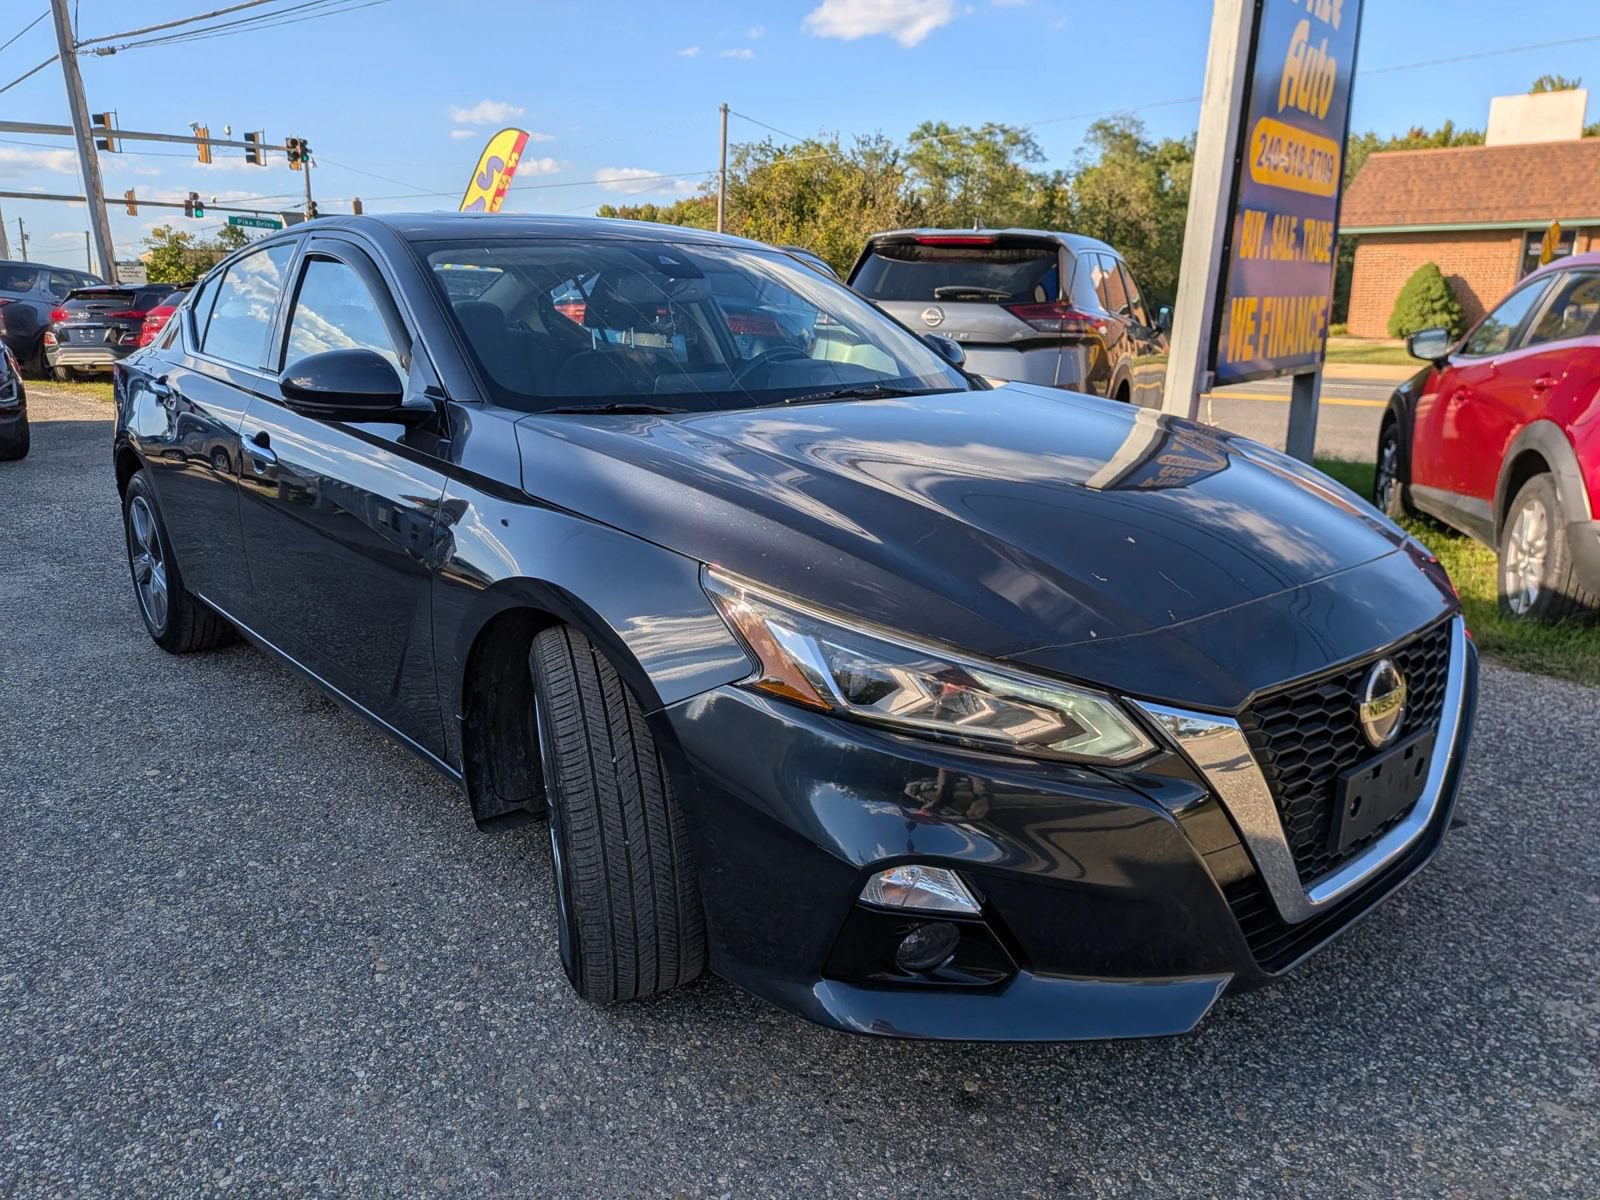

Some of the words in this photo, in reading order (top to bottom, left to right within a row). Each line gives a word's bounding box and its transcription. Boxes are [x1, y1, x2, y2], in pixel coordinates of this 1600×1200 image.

[1279, 19, 1336, 120] Auto
[1302, 218, 1333, 263] TRADE
[1227, 297, 1258, 363] WE
[1258, 296, 1327, 359] FINANCE
